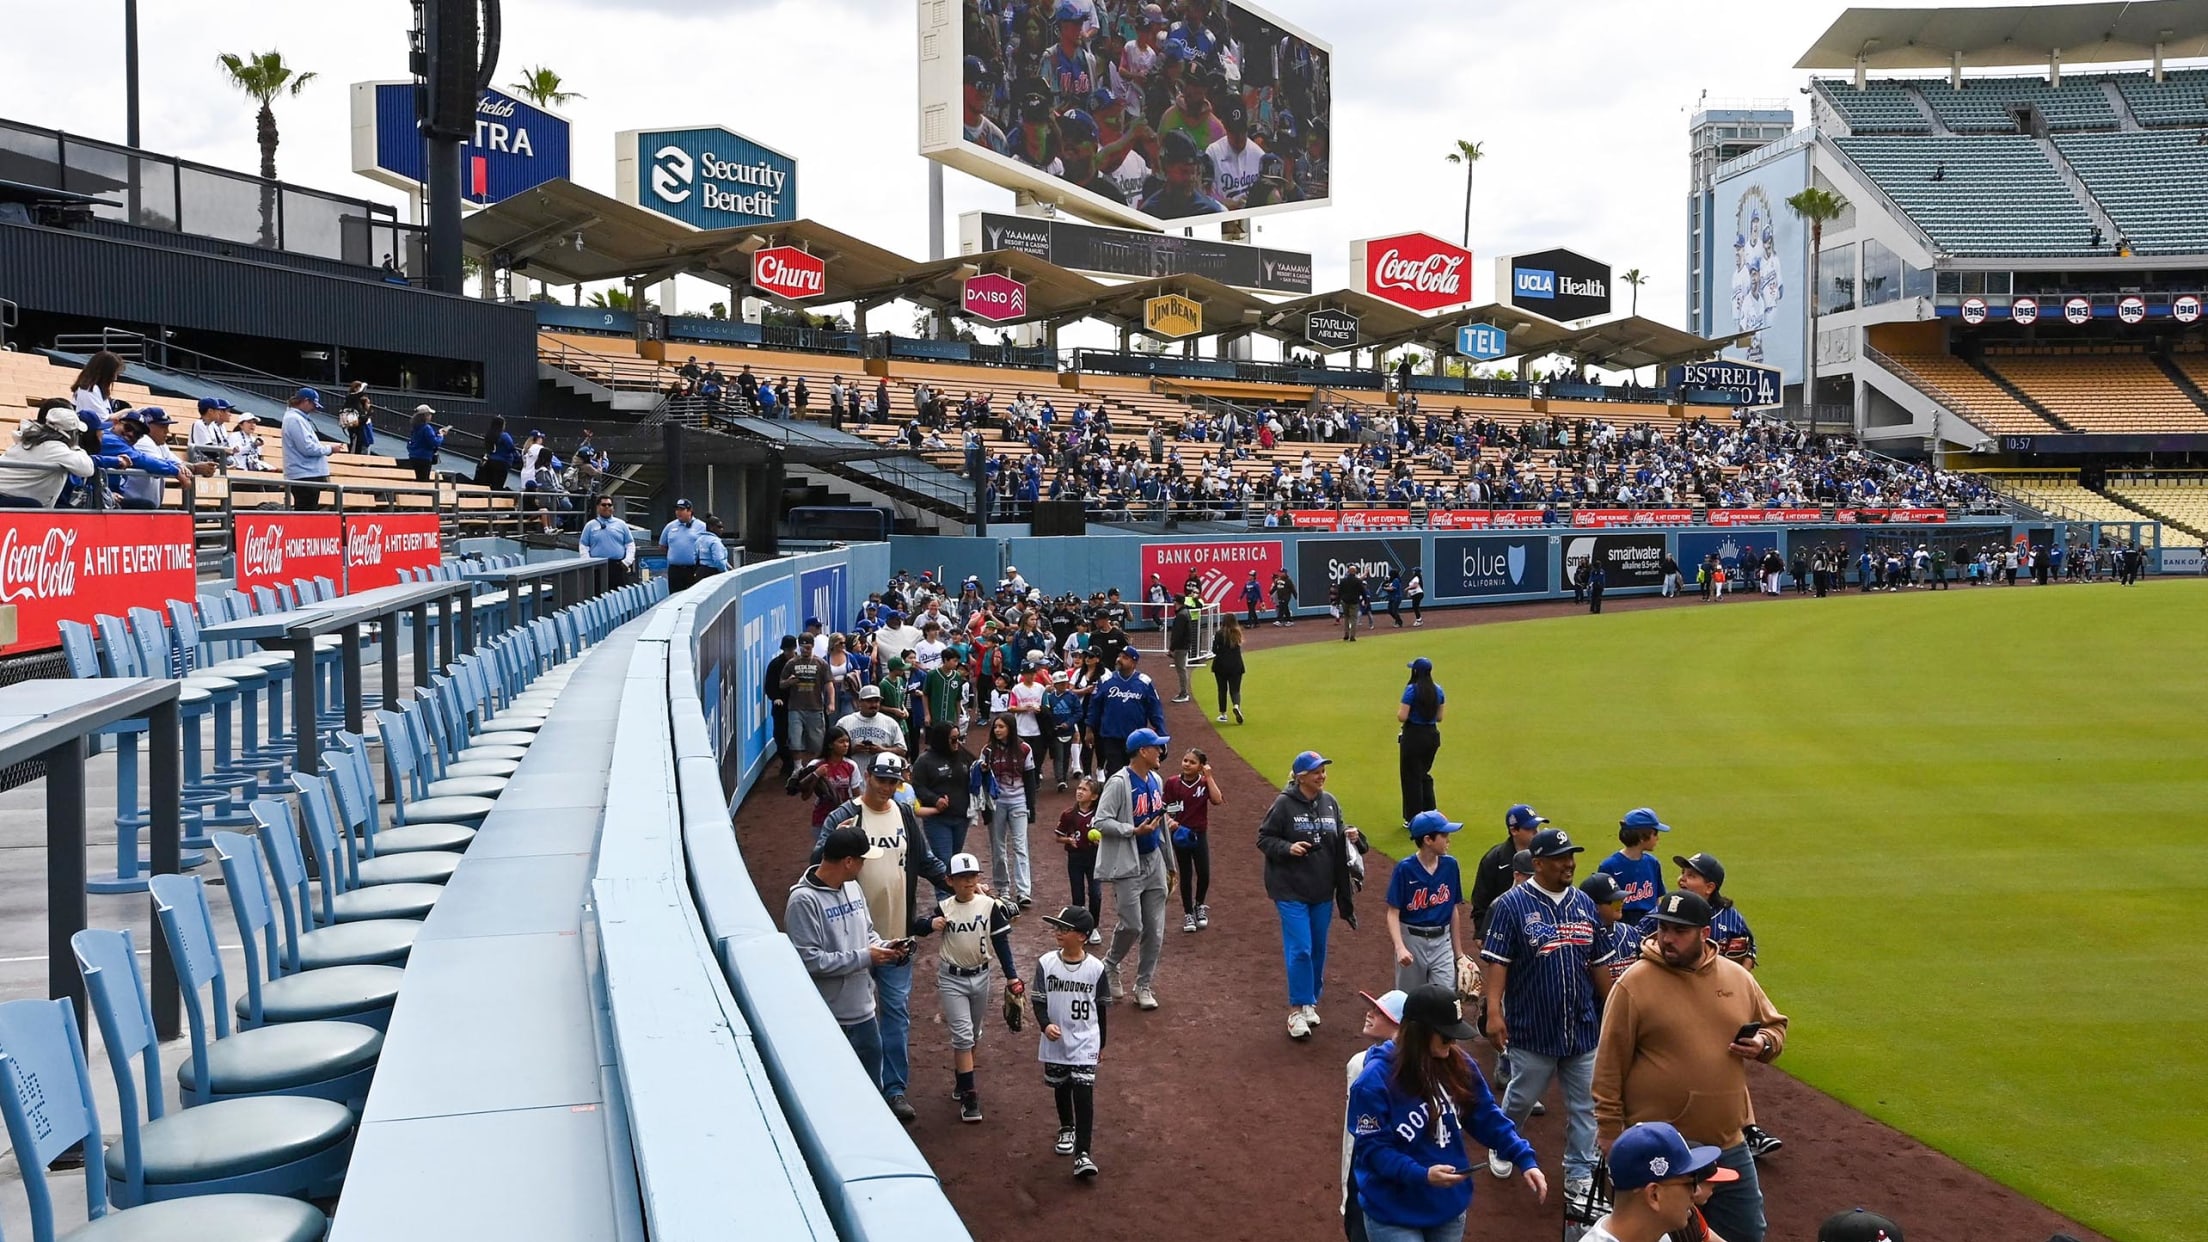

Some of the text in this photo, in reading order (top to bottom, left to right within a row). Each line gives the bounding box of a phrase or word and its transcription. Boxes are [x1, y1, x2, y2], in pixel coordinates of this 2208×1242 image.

[473, 120, 534, 157] TRA
[701, 152, 786, 195] Security
[702, 182, 776, 218] Benefit
[1004, 238, 1049, 250] RESORT & CASINO
[1024, 247, 1045, 256] MANUEL
[757, 255, 822, 291] Churu
[1375, 249, 1465, 294] Coca-Cola
[1518, 274, 1606, 298] UCLA Health
[967, 289, 1008, 304] DAISO
[1151, 298, 1197, 329] JIM BEAM
[1964, 306, 1985, 317] 1955
[2014, 306, 2036, 317] 1959
[2067, 306, 2089, 317] 1963
[2120, 305, 2143, 317] 1965
[2175, 304, 2199, 316] 1981
[1311, 317, 1356, 332] STARLUX
[1318, 330, 1349, 340] AIRLINES
[1464, 328, 1501, 355] TEL
[2005, 437, 2031, 450] 10:57
[1341, 512, 1366, 527] Coca-Cola
[1380, 515, 1396, 523] EVERY
[1396, 515, 1409, 523] TIME
[347, 523, 438, 567] Coca-Cola A HIT EVERY TIME
[1550, 536, 1560, 545] 375
[244, 524, 285, 577] Coca-Cola
[285, 538, 306, 558] HOME
[306, 538, 319, 557] RUN
[320, 537, 340, 556] MAGIC
[1157, 546, 1268, 565] BANK OF AMERICA
[1608, 545, 1661, 561] smartwater
[0, 527, 193, 603] Coca-Cola A HIT EVERY TIME
[1463, 547, 1506, 577] blue
[1622, 561, 1641, 570] alkaline
[2163, 558, 2187, 566] BANK
[1463, 578, 1506, 588] CALIFORNIA
[771, 604, 787, 643] TOKYO
[1108, 686, 1143, 704] Dodgers
[1407, 883, 1451, 911] Mets
[947, 919, 988, 933] NAVY
[980, 936, 986, 954] 6
[1071, 999, 1090, 1021] 99
